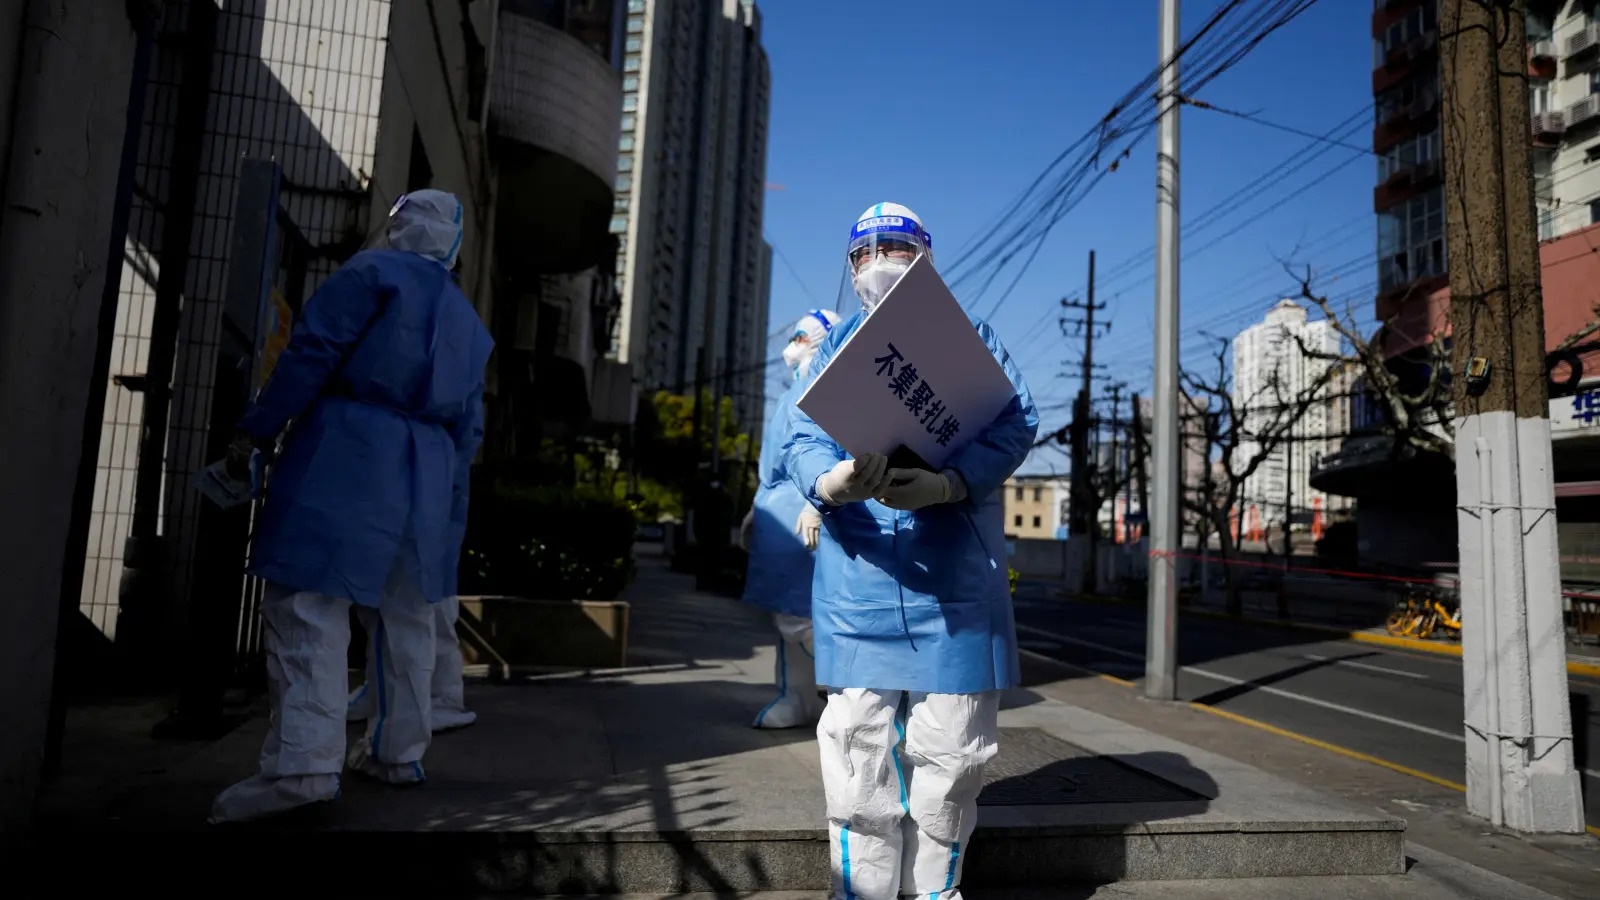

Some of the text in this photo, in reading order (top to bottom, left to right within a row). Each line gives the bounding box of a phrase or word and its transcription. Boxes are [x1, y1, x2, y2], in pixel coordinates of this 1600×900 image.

[875, 342, 960, 447] 不集聚扎堆
